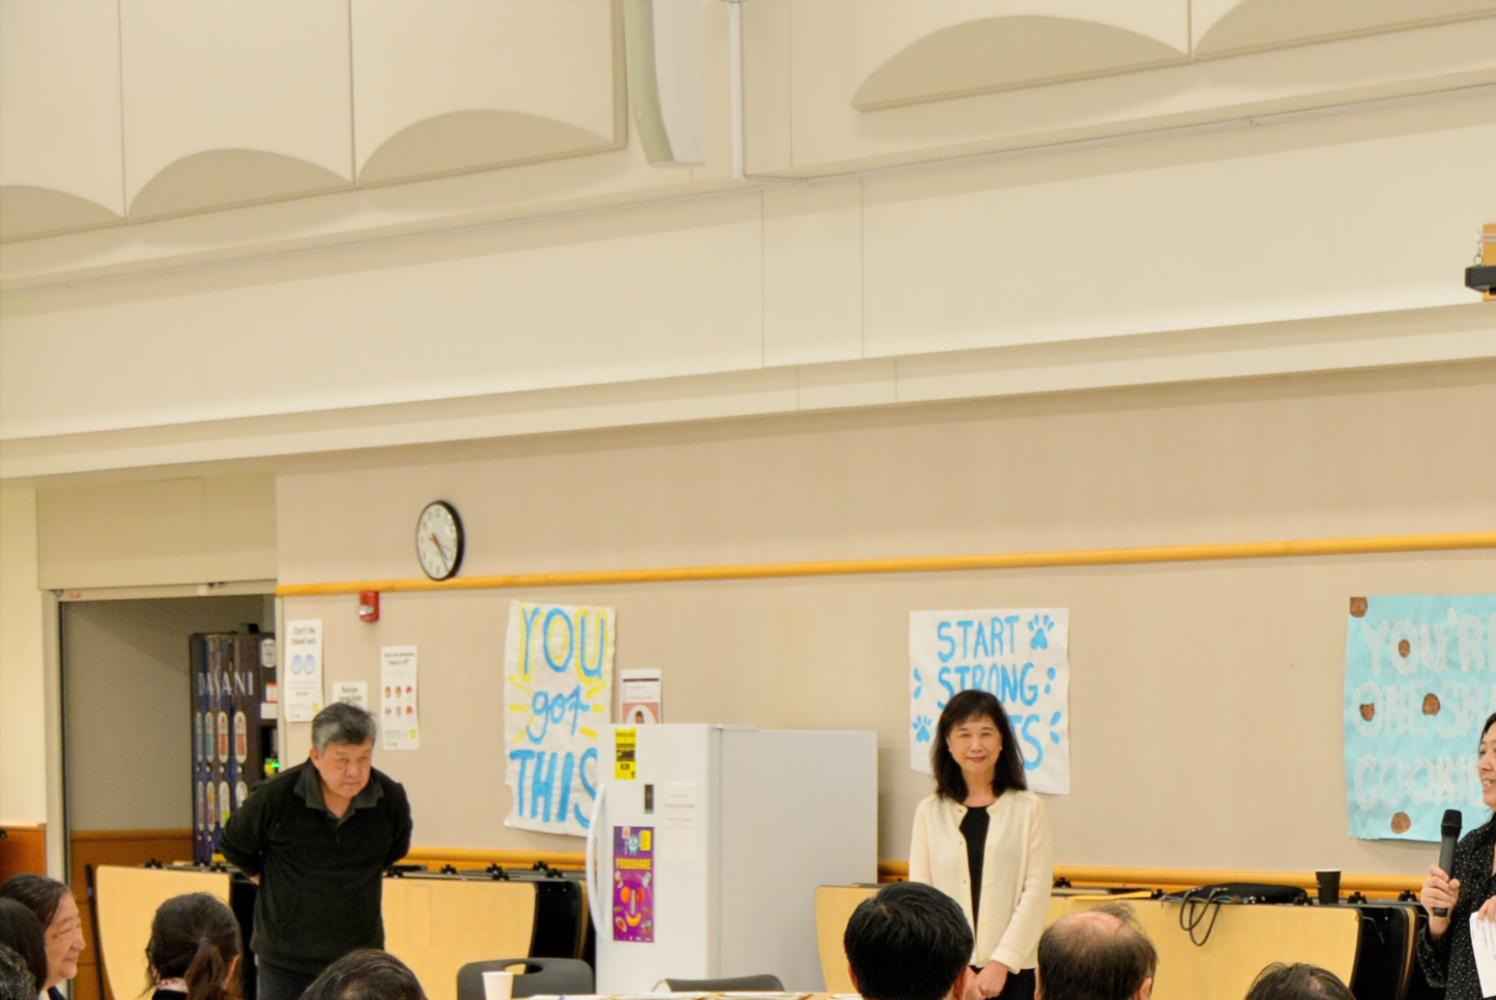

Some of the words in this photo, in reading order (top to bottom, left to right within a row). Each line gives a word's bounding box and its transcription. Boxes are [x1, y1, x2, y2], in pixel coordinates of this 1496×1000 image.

[521, 605, 606, 679] YOU
[937, 615, 1021, 662] START
[197, 671, 254, 696] DASANI
[937, 662, 1039, 709] STRONG
[1353, 681, 1430, 737] ONE
[526, 684, 590, 744] got
[509, 748, 598, 829] THIS
